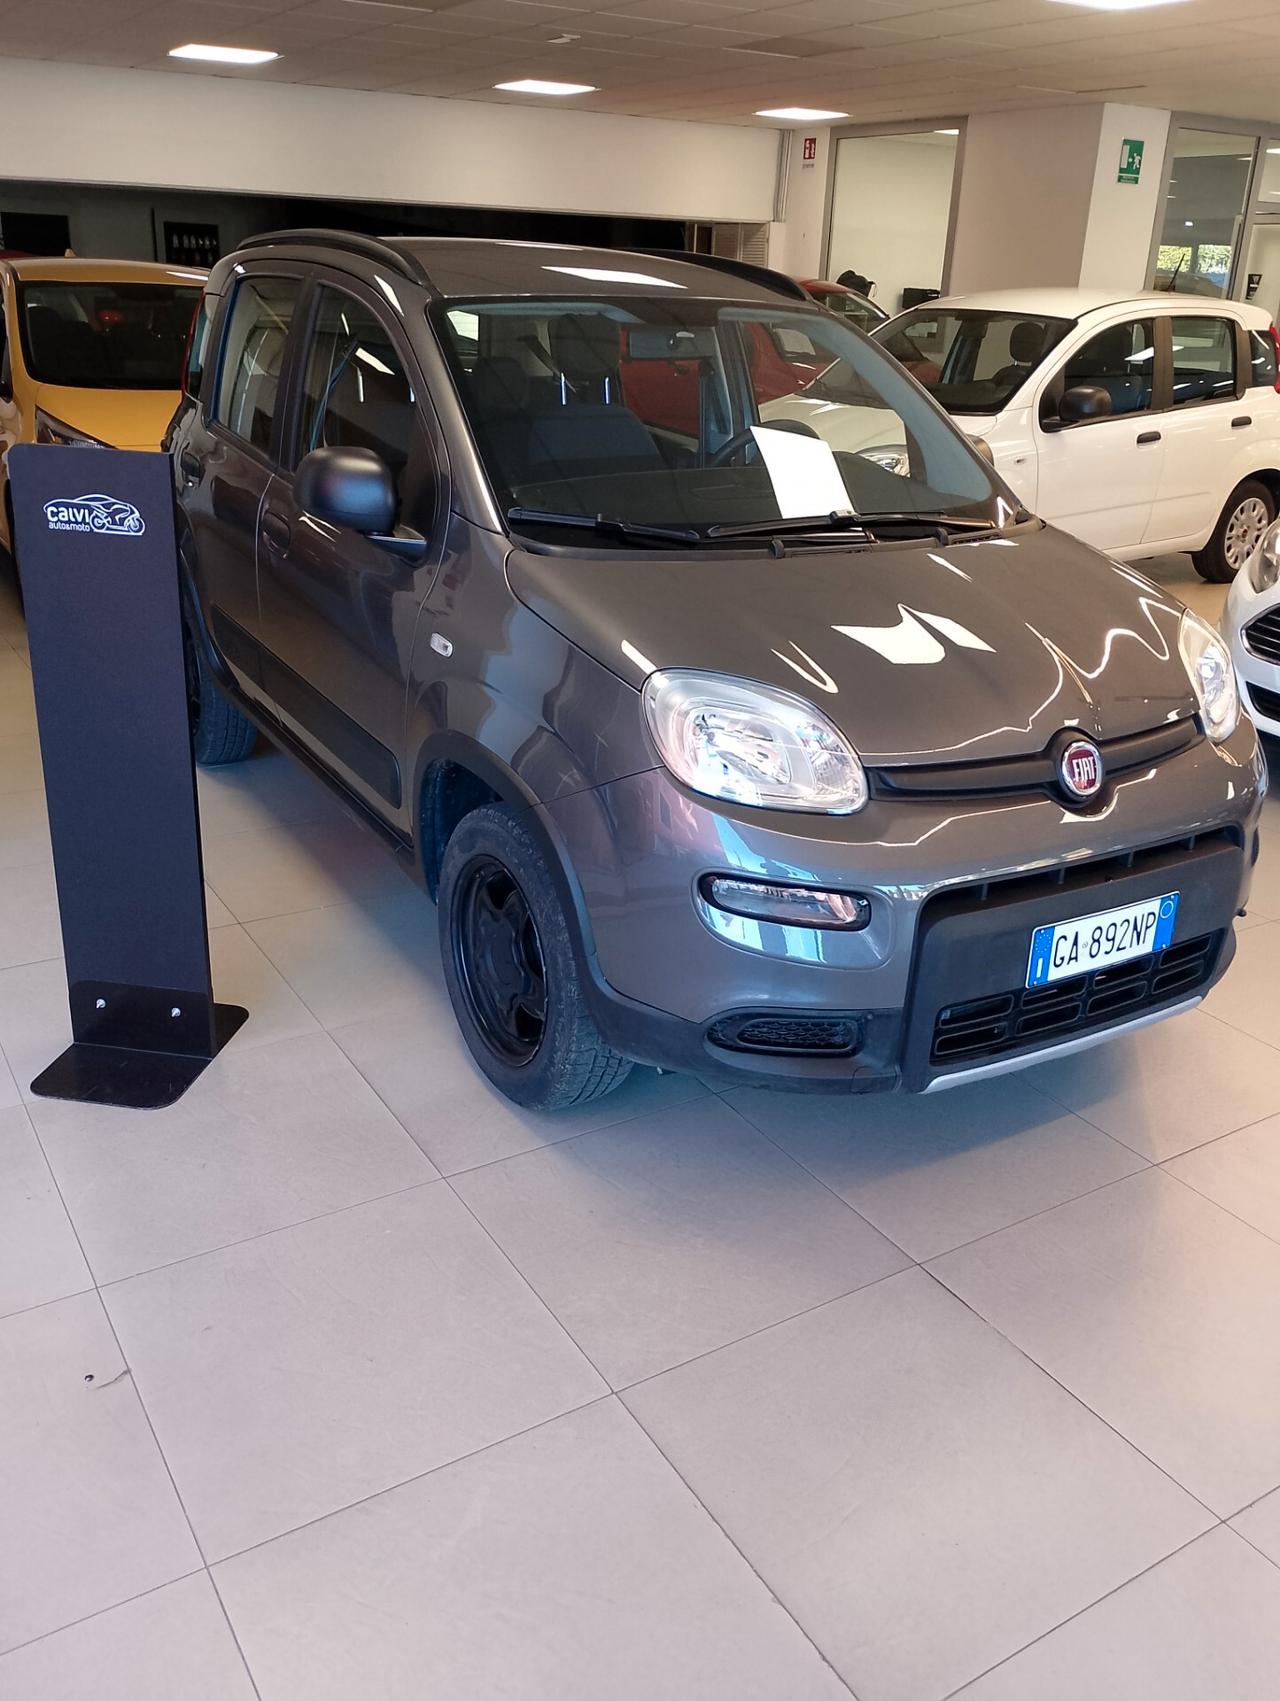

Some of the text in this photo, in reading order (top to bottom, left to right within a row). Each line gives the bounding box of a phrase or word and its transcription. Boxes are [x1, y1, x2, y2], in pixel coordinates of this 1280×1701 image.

[48, 521, 91, 532] auto&moto
[1072, 756, 1096, 782] FIAT
[1036, 957, 1044, 978] I
